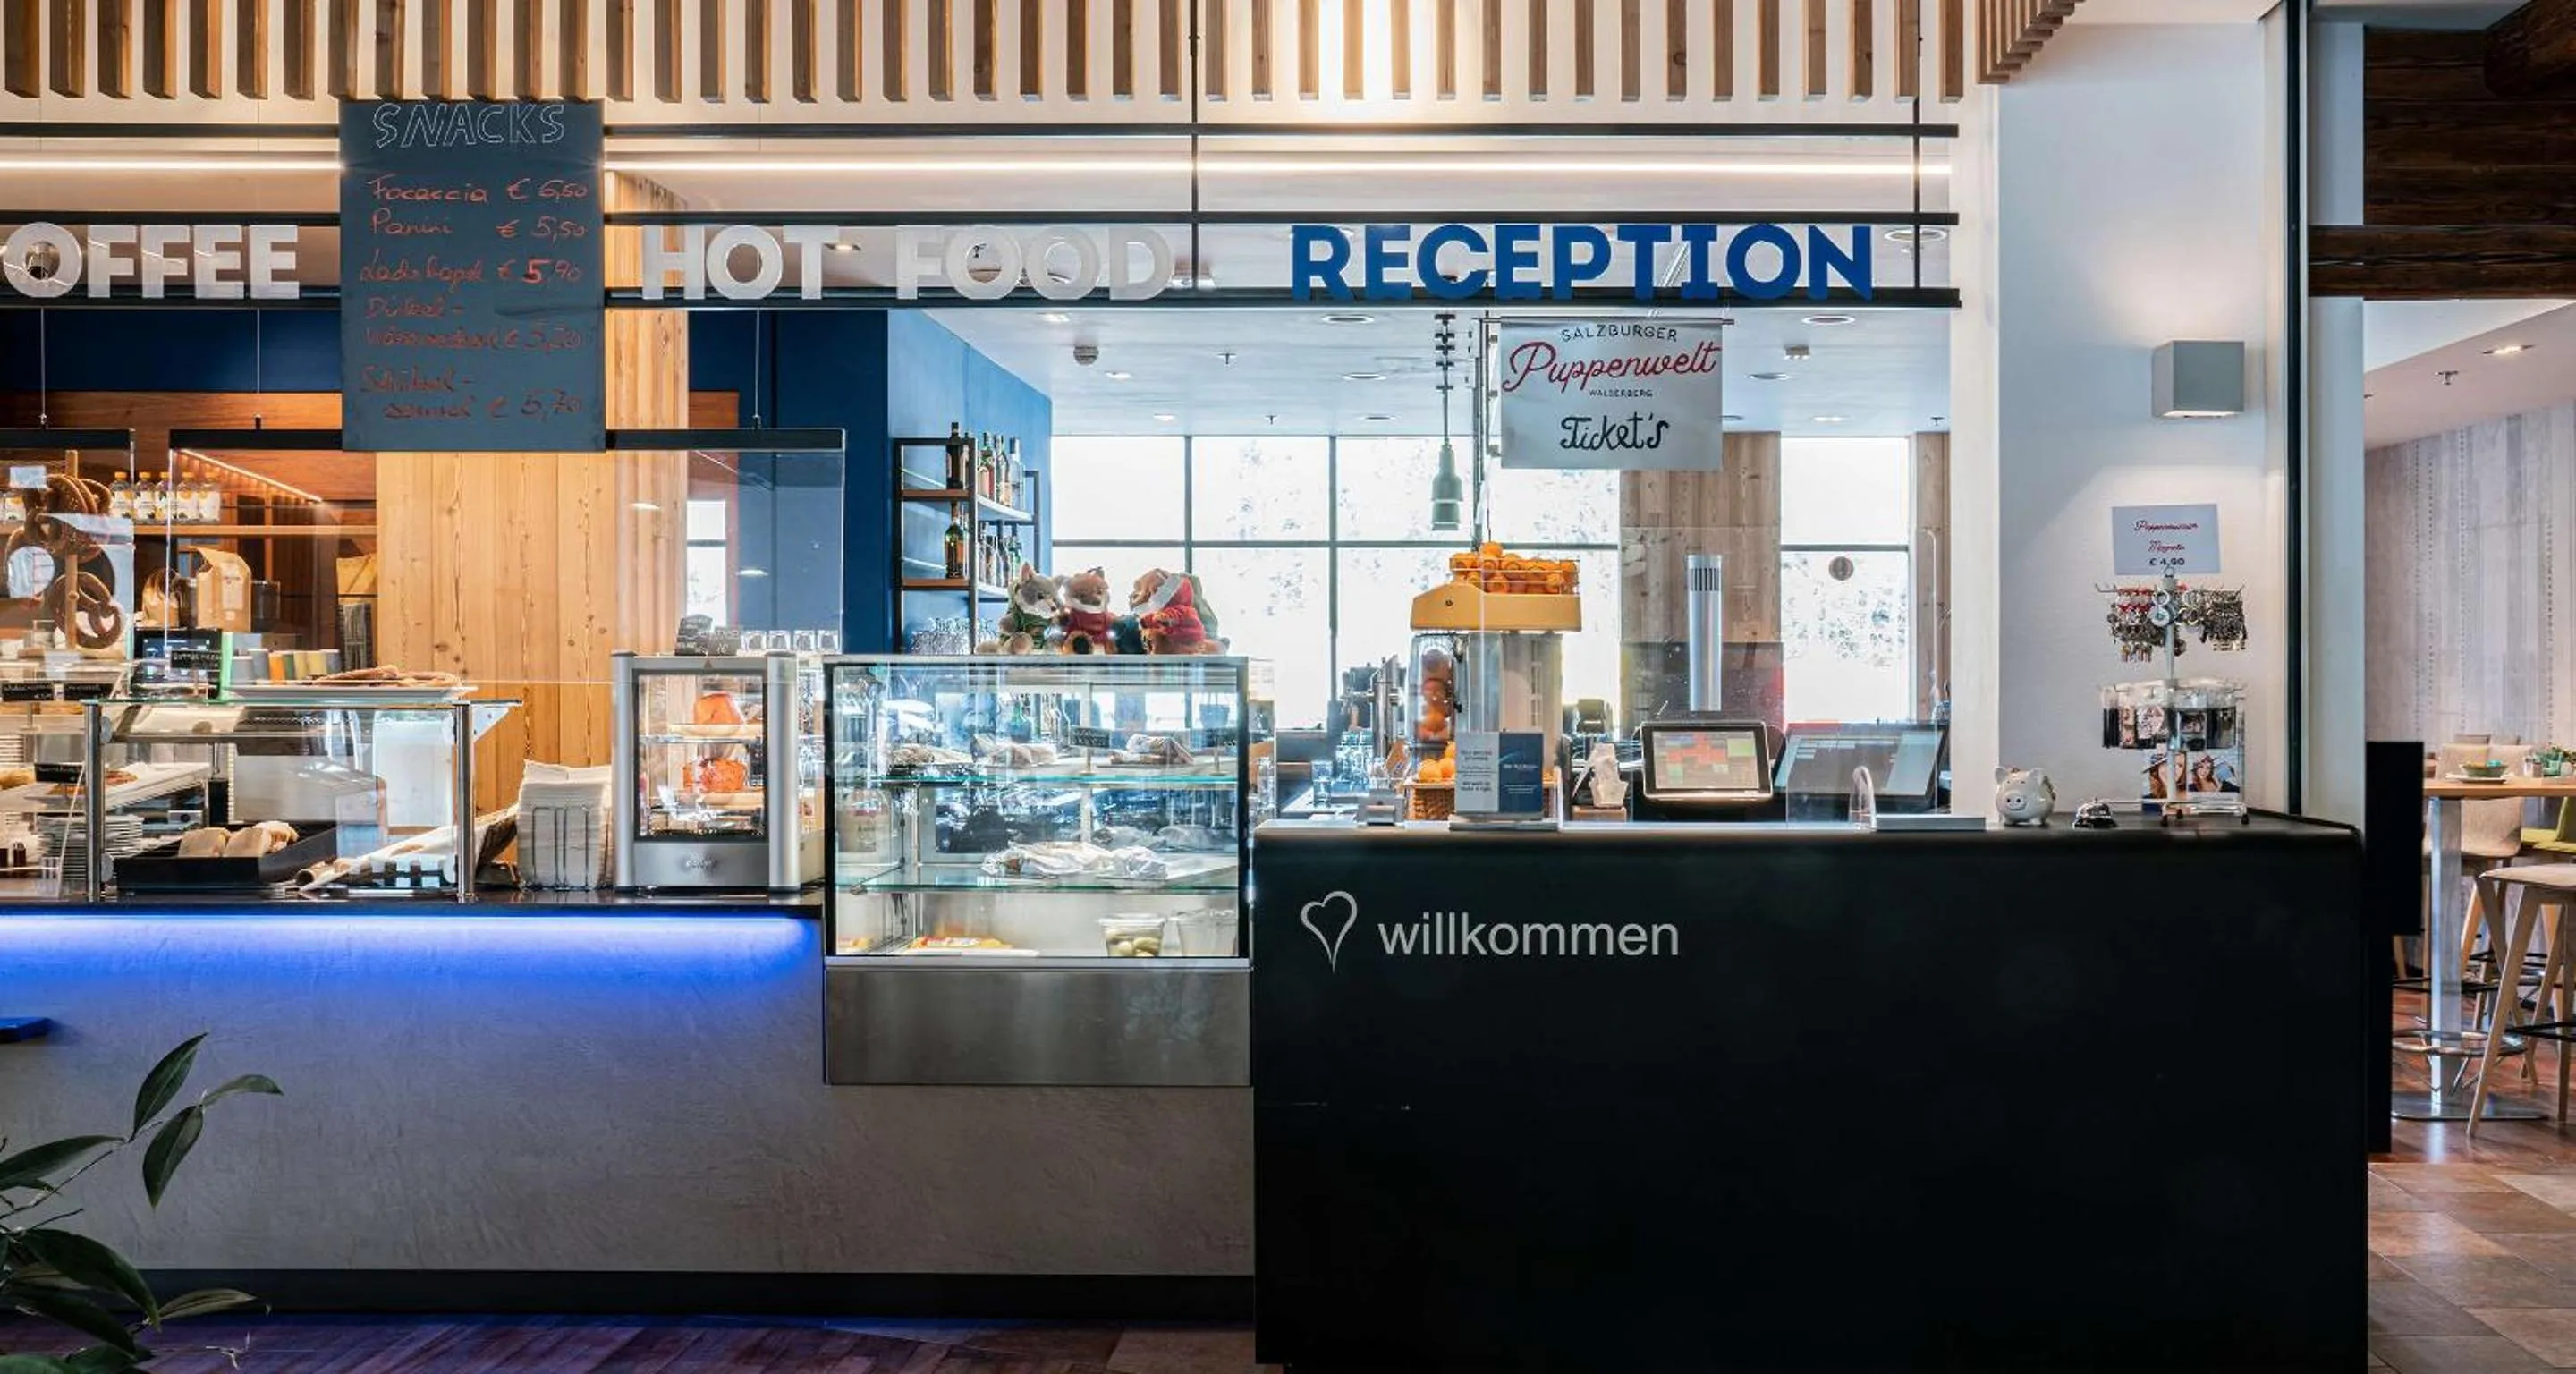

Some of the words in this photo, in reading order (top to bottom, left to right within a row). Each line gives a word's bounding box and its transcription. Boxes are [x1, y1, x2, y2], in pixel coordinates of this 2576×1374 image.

[372, 102, 565, 149] SNACKS
[367, 174, 488, 204] Focaccia
[371, 208, 453, 235] Panini
[641, 224, 839, 301] HOT
[894, 224, 1174, 301] FOOD
[1291, 223, 1873, 301] RECEPTION
[1561, 324, 1678, 343] SALZBURGER
[1501, 340, 1722, 394] Puppenwelt
[1559, 411, 1670, 451] Ticket's
[1377, 912, 1680, 956] willkommen
